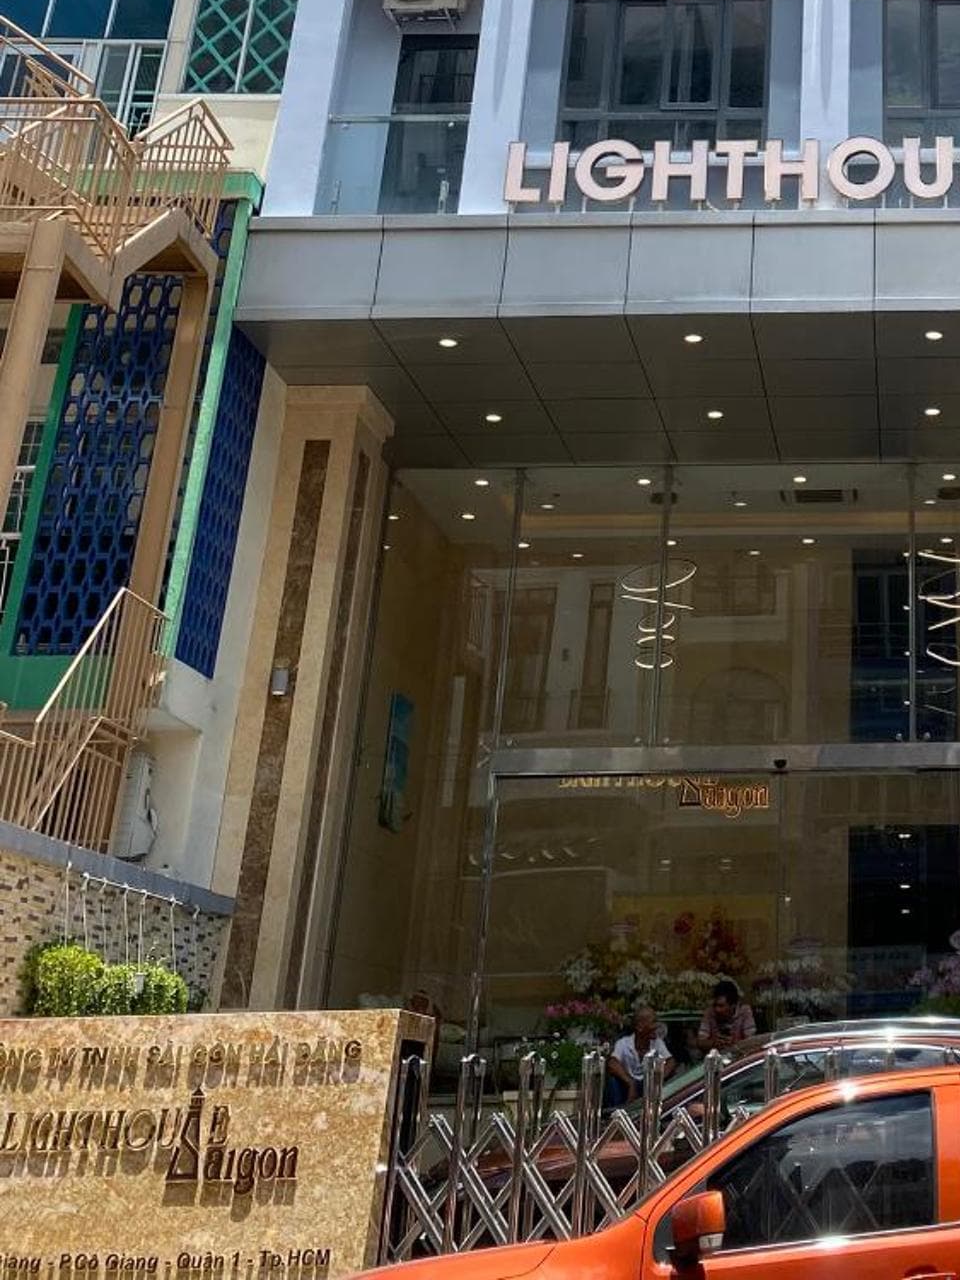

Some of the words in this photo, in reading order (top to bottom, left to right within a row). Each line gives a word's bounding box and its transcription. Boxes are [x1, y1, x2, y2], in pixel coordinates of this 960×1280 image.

[0, 1253, 42, 1273] iang
[106, 1252, 159, 1273] Giang
[177, 1251, 225, 1272] Quận
[231, 1251, 240, 1269] 1
